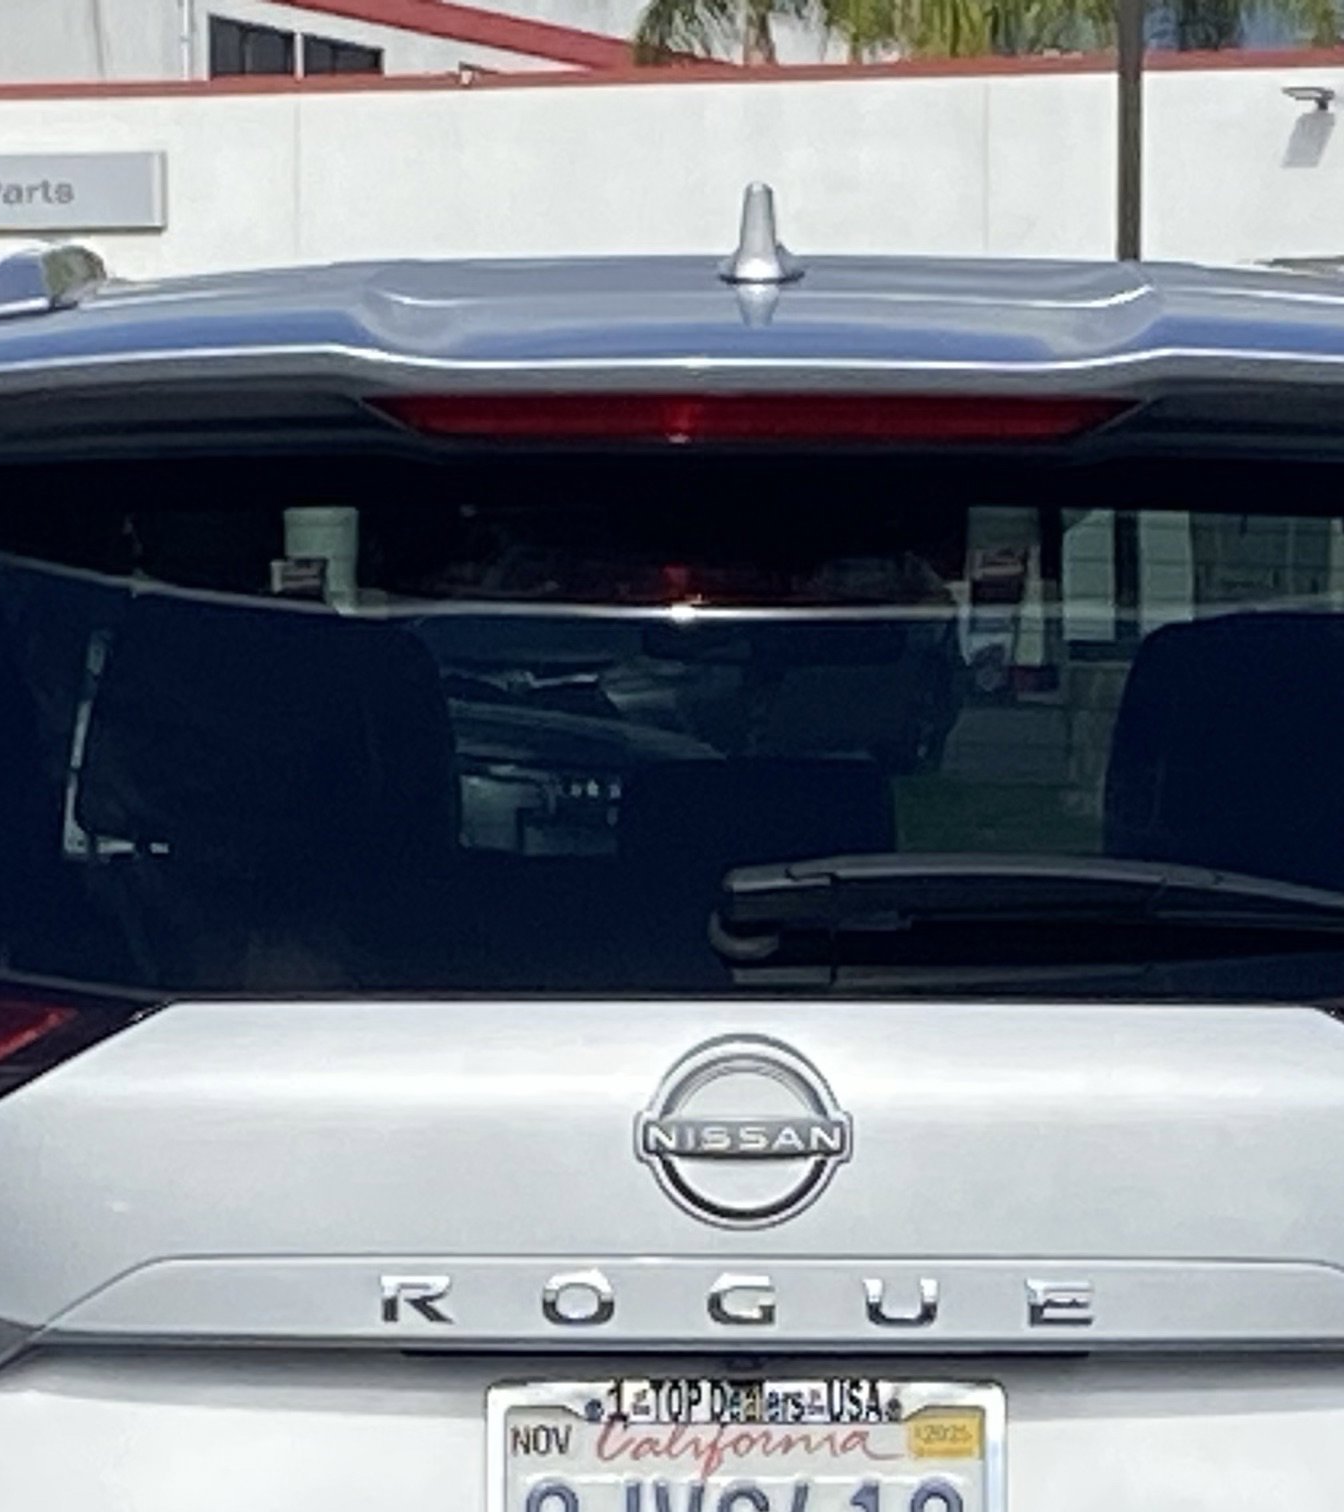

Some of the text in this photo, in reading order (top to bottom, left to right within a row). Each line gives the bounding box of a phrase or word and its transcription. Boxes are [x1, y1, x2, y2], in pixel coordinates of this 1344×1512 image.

[648, 1126, 841, 1151] NISSAN
[380, 1268, 1094, 1326] ROGUE
[649, 1379, 703, 1423] TOP
[826, 1379, 882, 1423] USA
[511, 1424, 572, 1455] NOV
[596, 1421, 906, 1478] California
